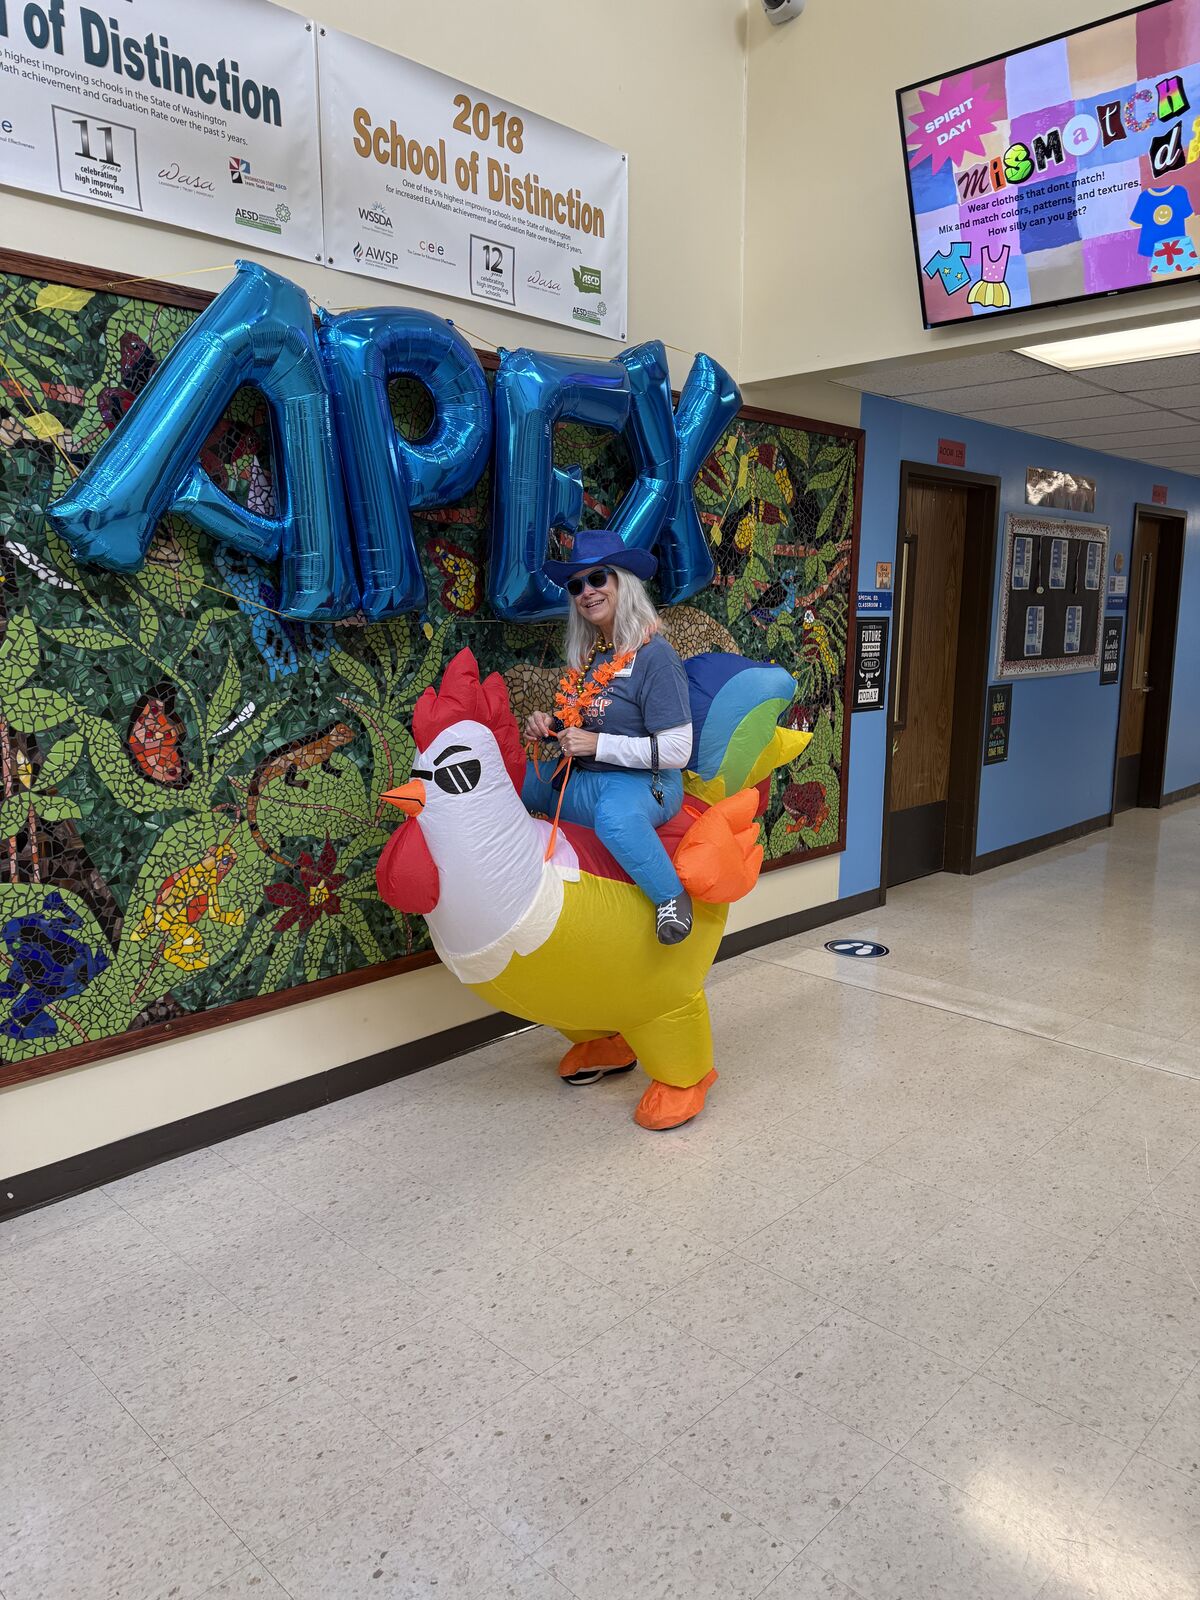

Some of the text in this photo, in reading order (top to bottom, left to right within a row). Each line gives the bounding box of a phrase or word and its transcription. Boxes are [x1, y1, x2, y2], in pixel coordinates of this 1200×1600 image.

[23, 0, 66, 56] of
[80, 6, 283, 127] Distinction
[4, 49, 227, 127] highest improving schools in the State of Washington
[21, 69, 82, 95] achievement
[83, 88, 100, 100] and
[101, 93, 149, 115] Graduation
[151, 108, 169, 121] Rate
[170, 115, 188, 127] over
[189, 120, 202, 132] the
[204, 126, 219, 136] past
[221, 130, 226, 139] 5
[227, 134, 249, 145] years.
[924, 97, 974, 134] SPIRIT
[453, 93, 524, 154] 2018
[936, 118, 972, 146] DAY!
[72, 119, 121, 168] 11
[75, 172, 125, 194] high improving
[80, 165, 118, 183] celebrating
[353, 107, 605, 239] School of Distinction
[89, 187, 113, 199] schools
[938, 179, 1142, 235] Mix and match colors, patterns, and textures.
[967, 171, 1105, 214] Wear clothes that dont match!
[235, 207, 259, 221] AESD
[358, 207, 393, 228] WSSDA
[385, 184, 394, 193] for
[395, 187, 424, 203] increased
[424, 196, 452, 212] ELA/Math
[452, 205, 487, 223] achievement
[487, 218, 497, 226] and
[498, 220, 526, 235] Graduation
[526, 229, 537, 239] Rate
[537, 234, 548, 243] over
[548, 236, 557, 246] the
[556, 240, 567, 249] past
[402, 178, 415, 190] One
[416, 183, 423, 191] of
[423, 186, 433, 195] the
[443, 191, 464, 206] highest
[464, 199, 492, 215] improving
[492, 209, 511, 221] schools
[517, 217, 526, 225] the
[526, 220, 539, 231] State
[539, 224, 545, 232] of
[545, 225, 571, 241] Washington
[987, 205, 1087, 237] How silly can you get?
[365, 246, 399, 265] AWSP
[482, 244, 503, 274] 12
[476, 280, 509, 295] high improving
[480, 275, 505, 288] celebrating
[485, 289, 502, 298] schools
[572, 306, 588, 317] AESD
[47, 259, 743, 623] APEX
[861, 630, 882, 642] FUTURE
[1103, 662, 1117, 673] HARD
[859, 690, 878, 701] TODAY
